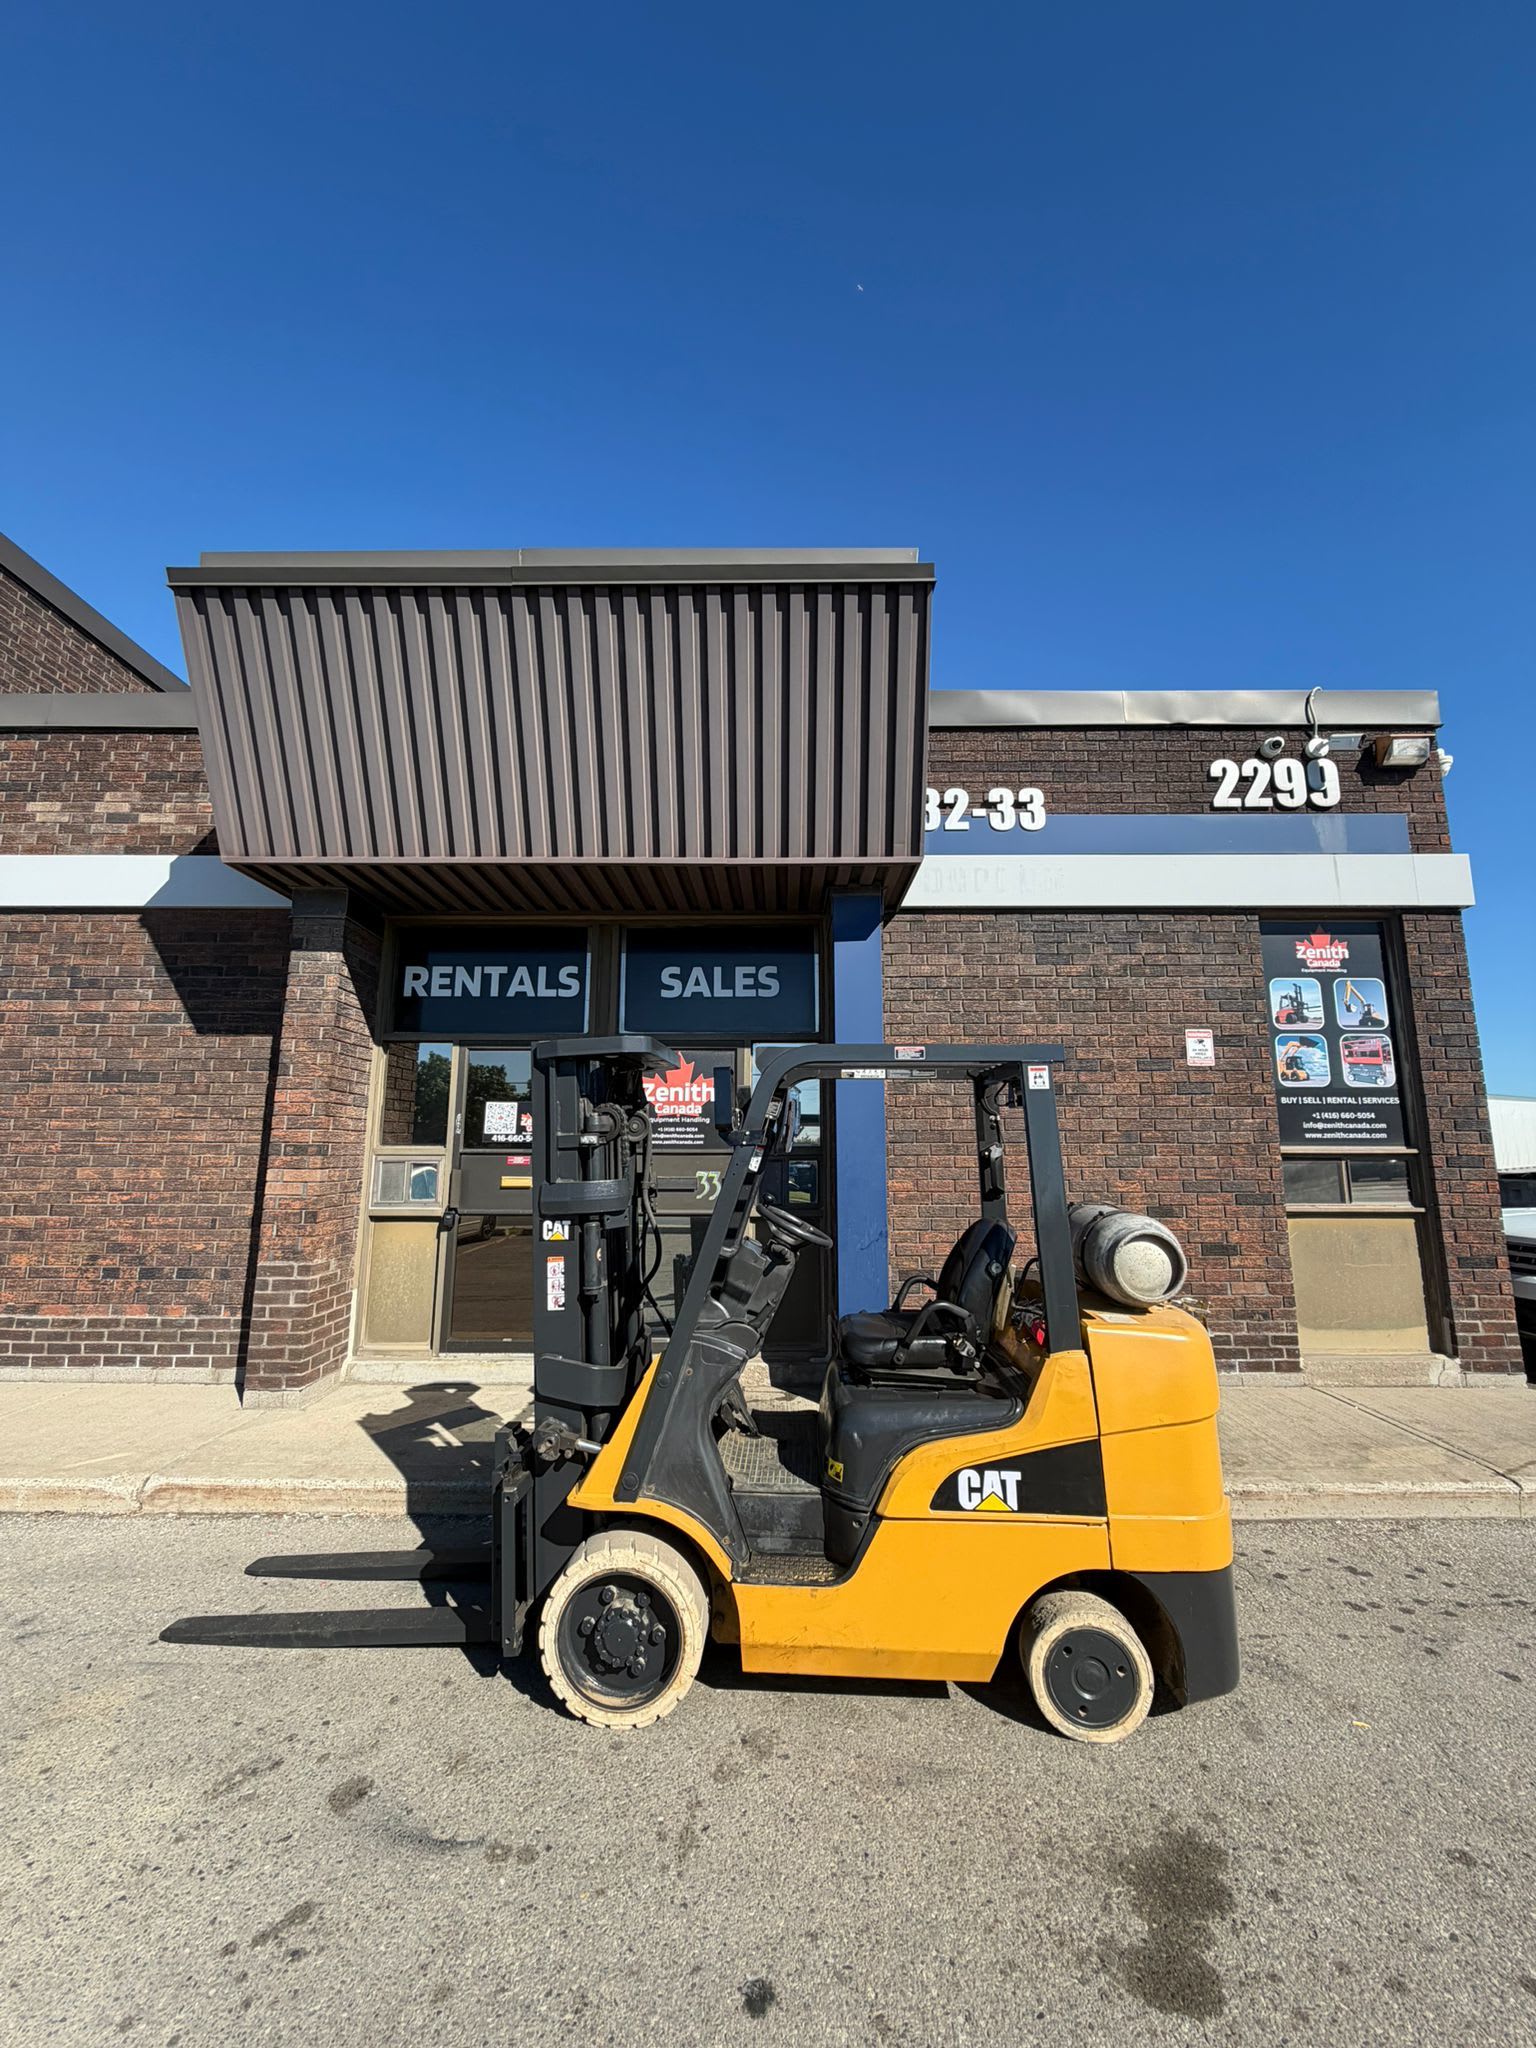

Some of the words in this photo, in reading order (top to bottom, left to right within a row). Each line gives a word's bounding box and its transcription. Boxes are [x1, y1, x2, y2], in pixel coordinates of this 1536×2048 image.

[1210, 758, 1341, 808] 2299
[924, 787, 1047, 831] 32-33
[1295, 945, 1350, 959] Zenith
[1306, 958, 1341, 967] Canada
[402, 965, 582, 998] RENTALS
[659, 965, 781, 998] SALES
[642, 1082, 715, 1102] Zenith
[1280, 1096, 1298, 1104] BUY
[1302, 1096, 1323, 1104] SELL
[1326, 1096, 1358, 1105] RENTAL
[1362, 1096, 1400, 1105] SERVICES
[654, 1103, 702, 1114] Canada
[1303, 1121, 1387, 1130] info@zenithcanada.com
[491, 1134, 534, 1143] 416-660-5
[695, 1170, 722, 1201] 33
[542, 1220, 572, 1241] CAT
[957, 1468, 1022, 1511] CAT
